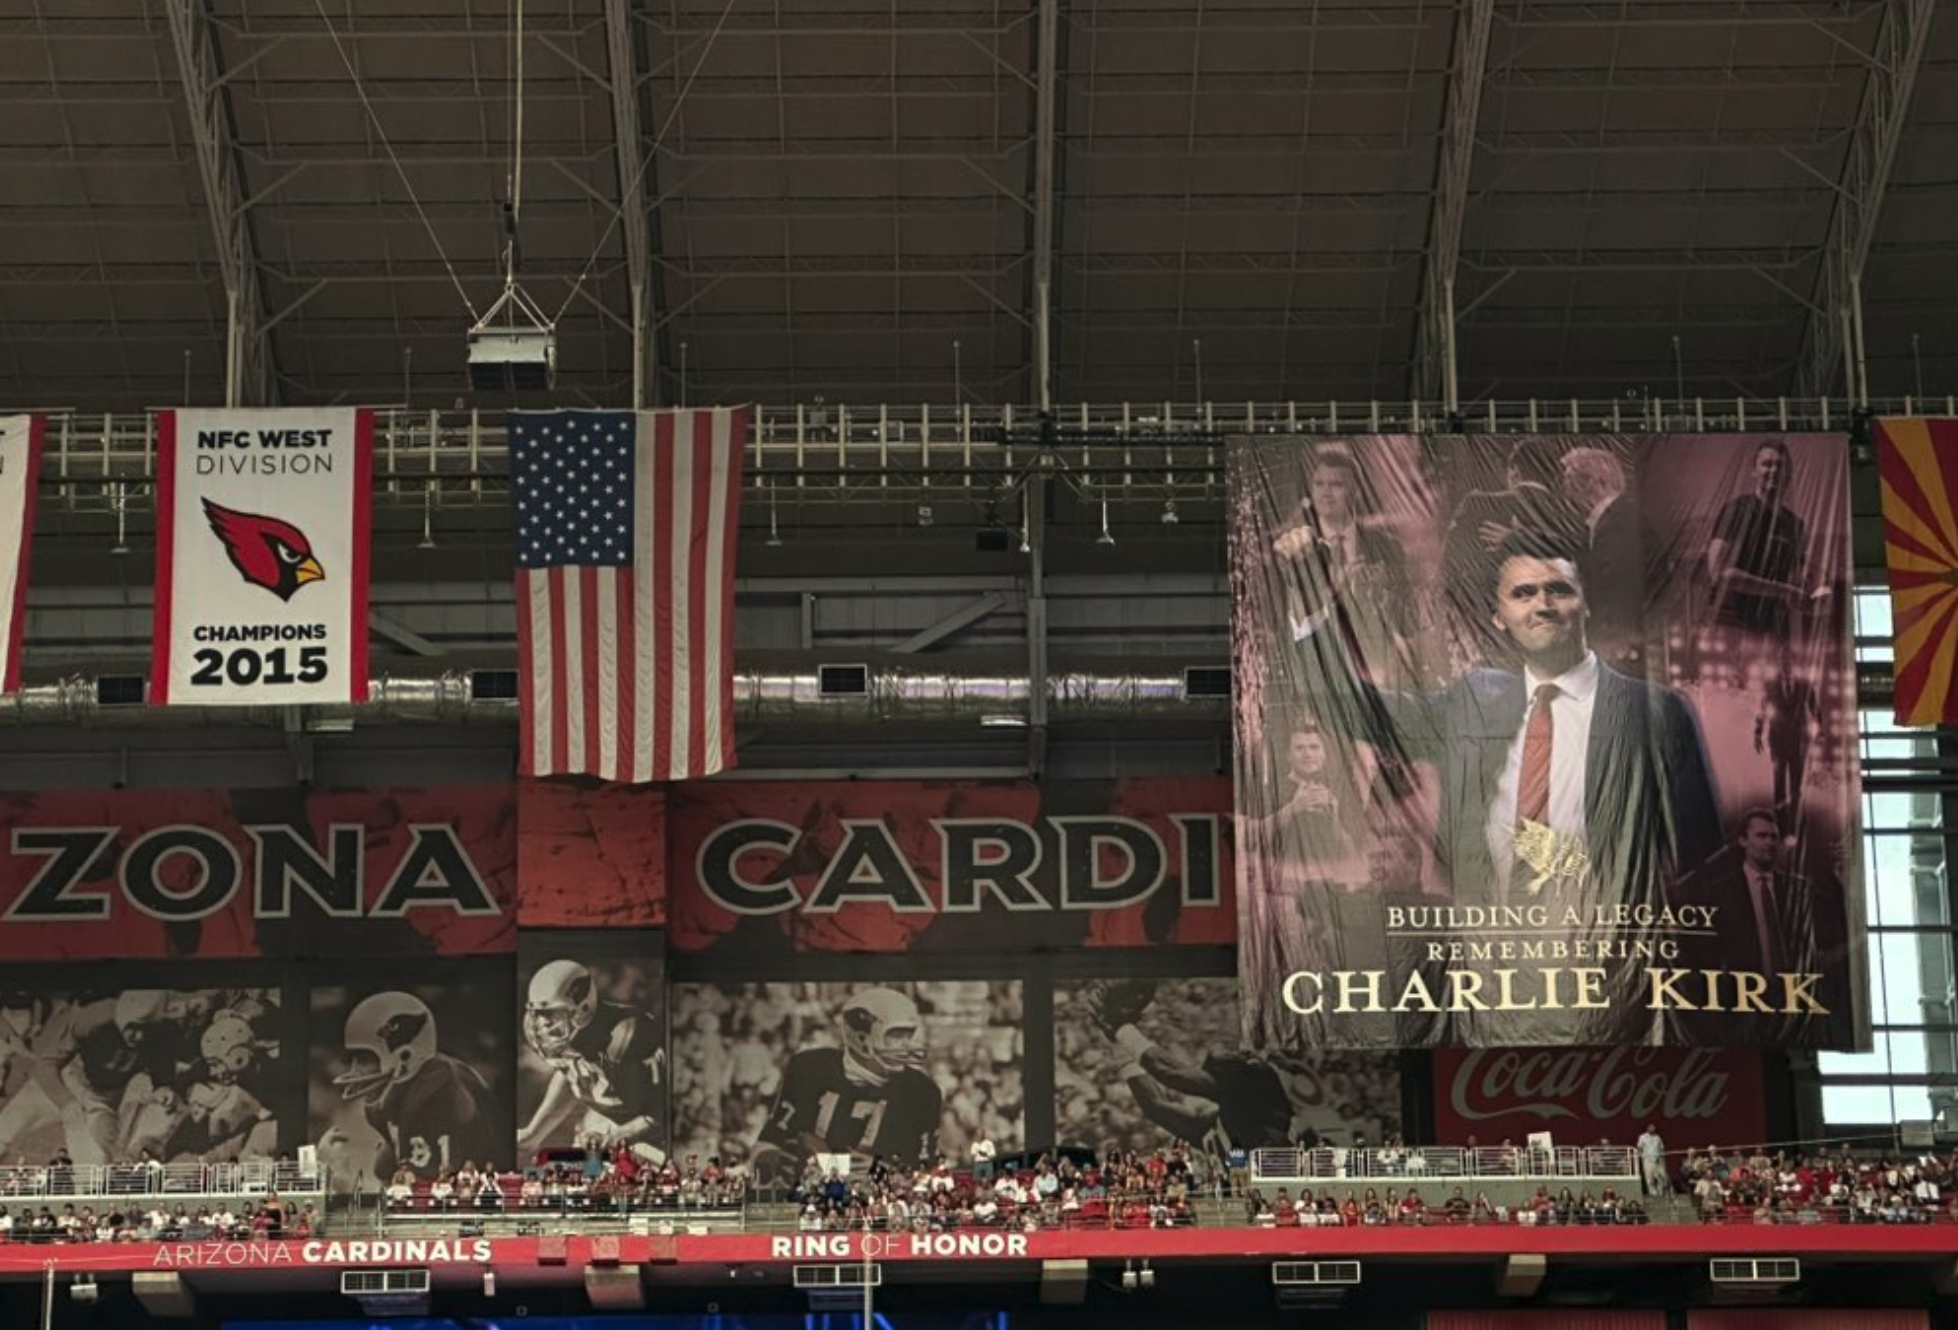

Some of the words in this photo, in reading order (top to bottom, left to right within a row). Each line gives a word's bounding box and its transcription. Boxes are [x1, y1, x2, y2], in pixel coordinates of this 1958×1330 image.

[197, 430, 250, 449] NFC
[257, 429, 333, 448] WEST
[196, 453, 333, 475] DIVISION
[193, 624, 327, 642] CHAMPIONS
[190, 646, 329, 686] 2015
[1, 823, 503, 921] ZONA
[695, 812, 1234, 915] CARDI
[1387, 906, 1548, 928] BUILDING
[1562, 905, 1582, 926] A
[1595, 904, 1718, 928] LEGACY
[1427, 939, 1680, 961] REMEMBERING
[1282, 967, 1611, 1015] CHARLIE
[1644, 967, 1832, 1016] KIRK
[814, 1091, 888, 1150] 17
[152, 1242, 293, 1266] ARIZONA
[302, 1240, 493, 1263] CARDINALS
[771, 1234, 851, 1257] RING
[860, 1233, 901, 1256] OF
[911, 1233, 1028, 1257] HONOR
